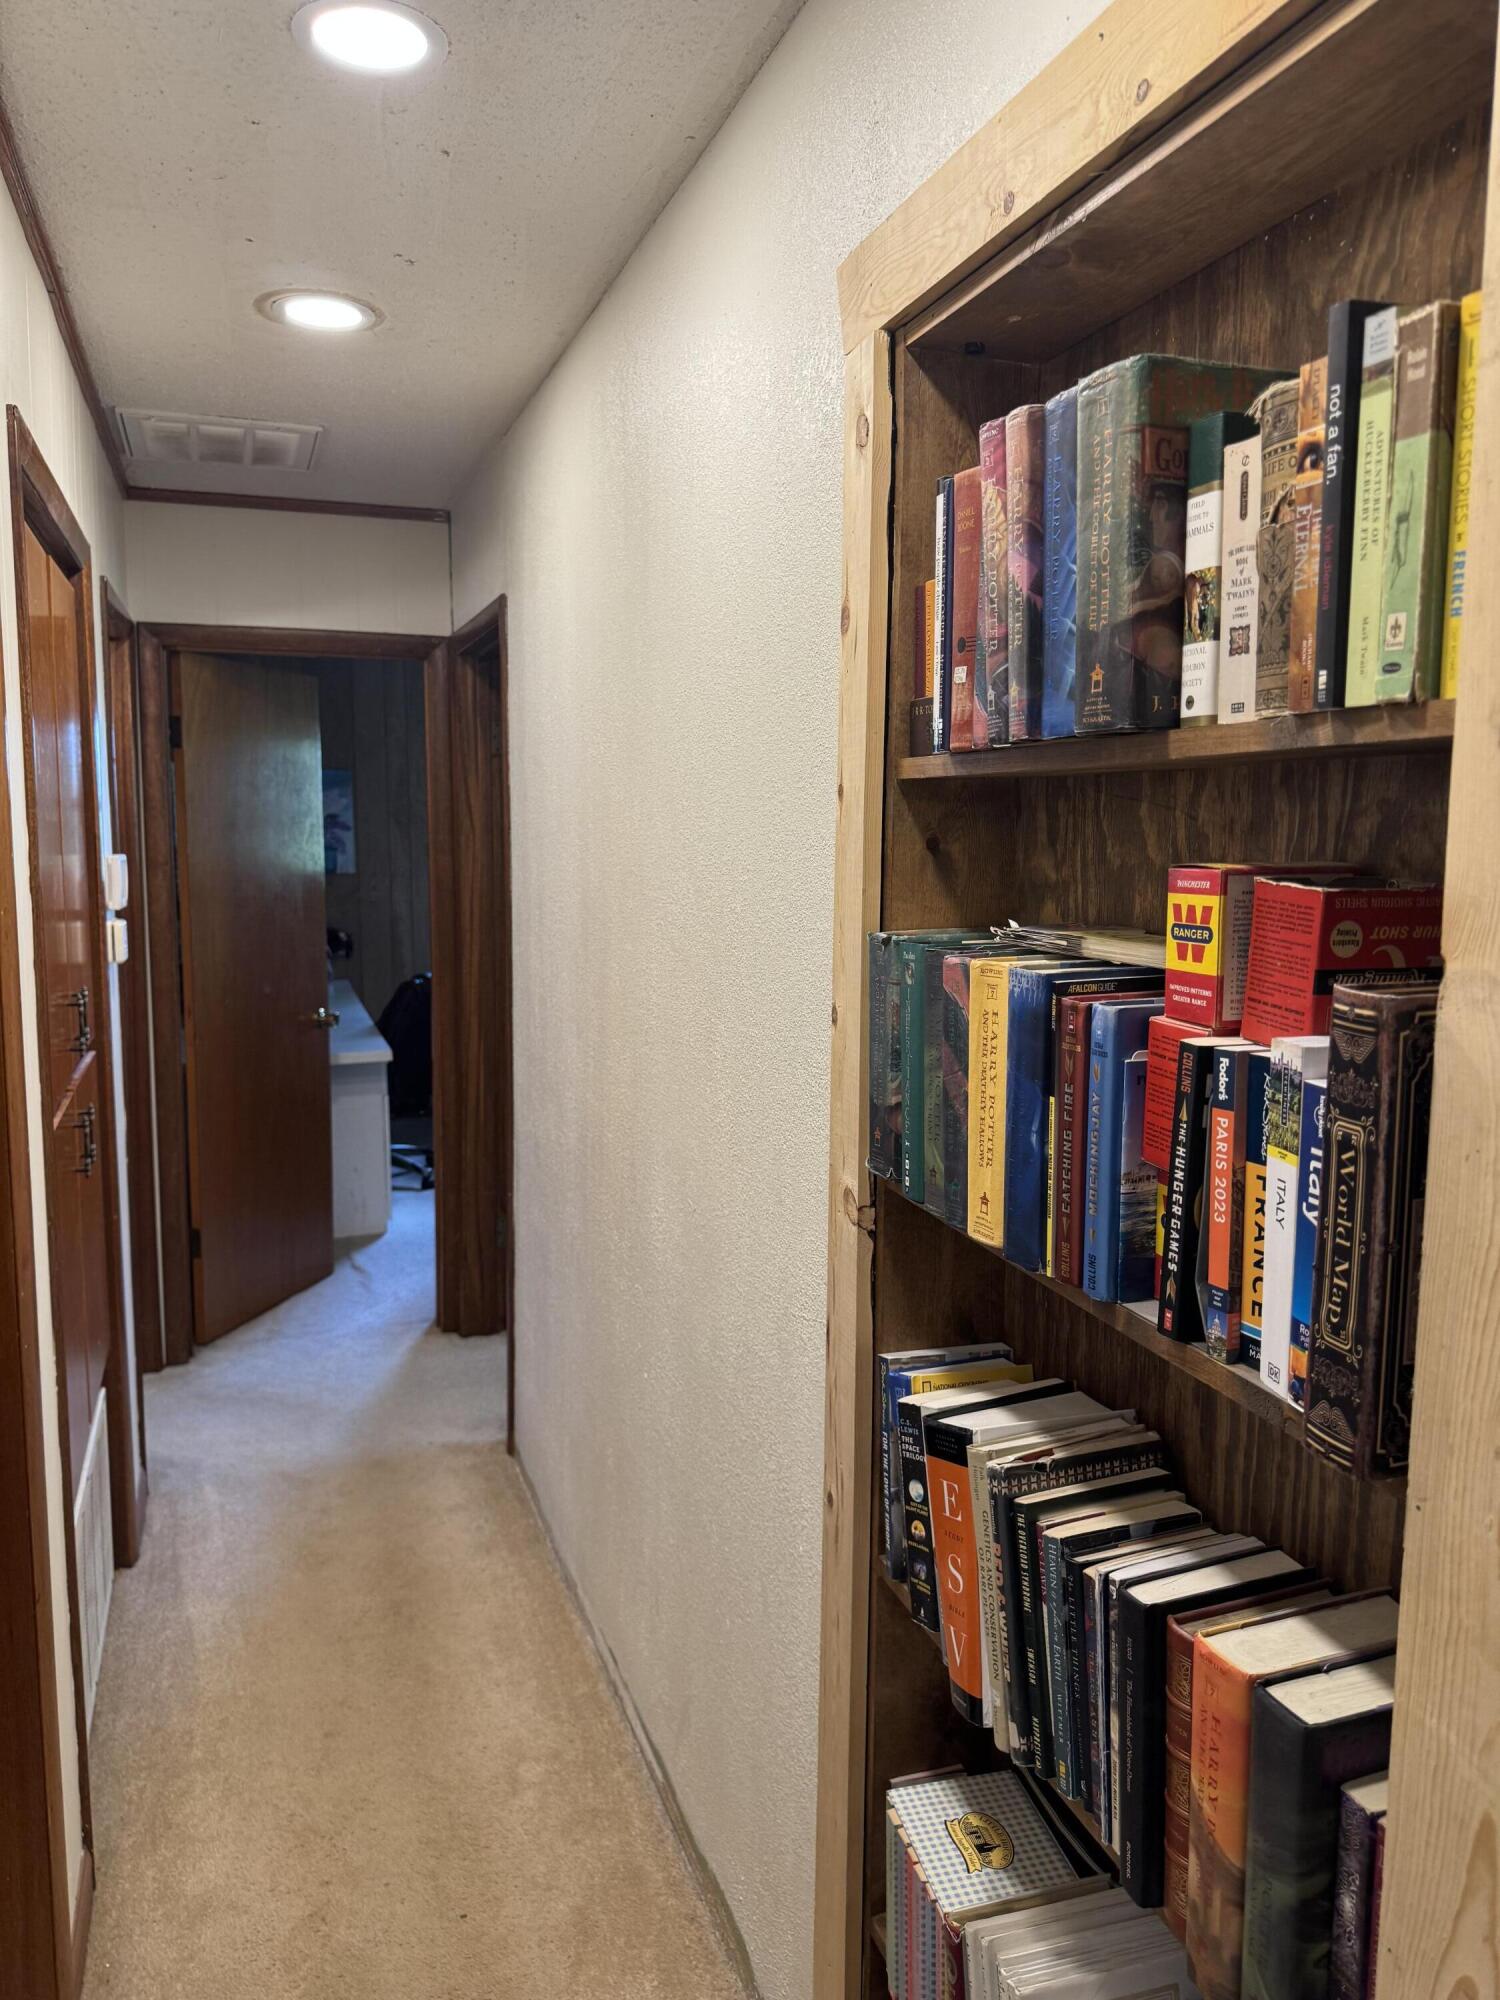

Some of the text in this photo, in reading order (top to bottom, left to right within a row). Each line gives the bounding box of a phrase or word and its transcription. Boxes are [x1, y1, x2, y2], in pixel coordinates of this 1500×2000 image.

[1459, 376, 1477, 445] SHORT
[1092, 433, 1102, 472] AND
[1325, 383, 1343, 486] not a fan.
[1264, 458, 1286, 479] LIFE
[1359, 419, 1375, 562] HUCKLEBERRY FINN
[1370, 429, 1386, 546] ADVENTURES OF
[1453, 448, 1474, 526] STORIES
[984, 477, 999, 561] HARRY
[1050, 455, 1064, 544] HARRY
[1190, 500, 1206, 511] FIELD
[1100, 427, 1115, 626] HARRY POTTER
[1293, 502, 1313, 593] ETERNAL
[1012, 466, 1025, 647] HARRY POTTER
[1226, 587, 1256, 601] TWAIN'S
[1230, 576, 1253, 589] MARK
[1450, 550, 1467, 618] FRENCH
[987, 569, 999, 651] POTTER
[1359, 615, 1370, 677] Mark Twain
[1176, 879, 1211, 890] WINCHESTER
[1335, 896, 1369, 909] SHELLS
[1173, 926, 1210, 941] RANGER
[1369, 926, 1408, 940] SHOT
[1169, 983, 1213, 998] IMPROVED PATTERNS
[1172, 993, 1208, 1007] GREATER RANGE
[977, 1009, 990, 1169] AND THE DEATHLY HALLOWS
[985, 1009, 1000, 1169] HARRY POTTER
[1180, 1051, 1194, 1095] COLLINS
[1217, 1056, 1230, 1102] Fodor's
[1317, 1095, 1326, 1139] lonely planet
[1062, 1081, 1075, 1214] CATCHING FIRE
[1088, 1092, 1101, 1217] MOCKINGJAY
[1213, 1116, 1230, 1224] PARIS 2023
[1166, 1122, 1188, 1273] THE HUNGER GAMES
[1275, 1177, 1287, 1231] ITALY
[1301, 1147, 1324, 1227] Italy
[1061, 1241, 1071, 1278] COLLINS
[1250, 1173, 1268, 1318] FRANCE
[1328, 1149, 1357, 1325] World Map
[1087, 1253, 1098, 1291] COLLINS
[1299, 1322, 1310, 1337] Ro
[1249, 1349, 1262, 1360] MA
[1269, 1369, 1280, 1380] DK
[932, 1381, 957, 1391] NATIONAL
[881, 1431, 889, 1450] FOR
[899, 1418, 912, 1427] C.S.
[900, 1425, 919, 1436] LEWIS
[901, 1435, 914, 1445] THE
[901, 1442, 921, 1454] SPACE
[882, 1472, 890, 1496] LOVE
[883, 1497, 890, 1509] OF
[939, 1477, 963, 1522] E
[883, 1509, 891, 1552] EUROPE
[943, 1529, 965, 1544] STUDY
[947, 1553, 964, 1594] S
[1016, 1512, 1033, 1614] THE OVERLOAD SYNDROME
[1038, 1559, 1047, 1597] LEWIS
[948, 1603, 966, 1618] BIBLE
[978, 1547, 991, 1638] OF RARE PLANTS
[982, 1510, 1000, 1681] GENETICS AND CONSERVATION
[992, 1541, 1011, 1683] RED WHITE
[1047, 1543, 1058, 1589] HEAVEN
[1053, 1644, 1063, 1681] EARTH
[1067, 1595, 1078, 1642] LITTLE
[948, 1623, 969, 1668] V
[1026, 1647, 1037, 1685] SWENSON
[1071, 1647, 1081, 1699] THINGS
[1126, 1679, 1134, 1694] The
[1207, 1711, 1221, 1813] HARRY
